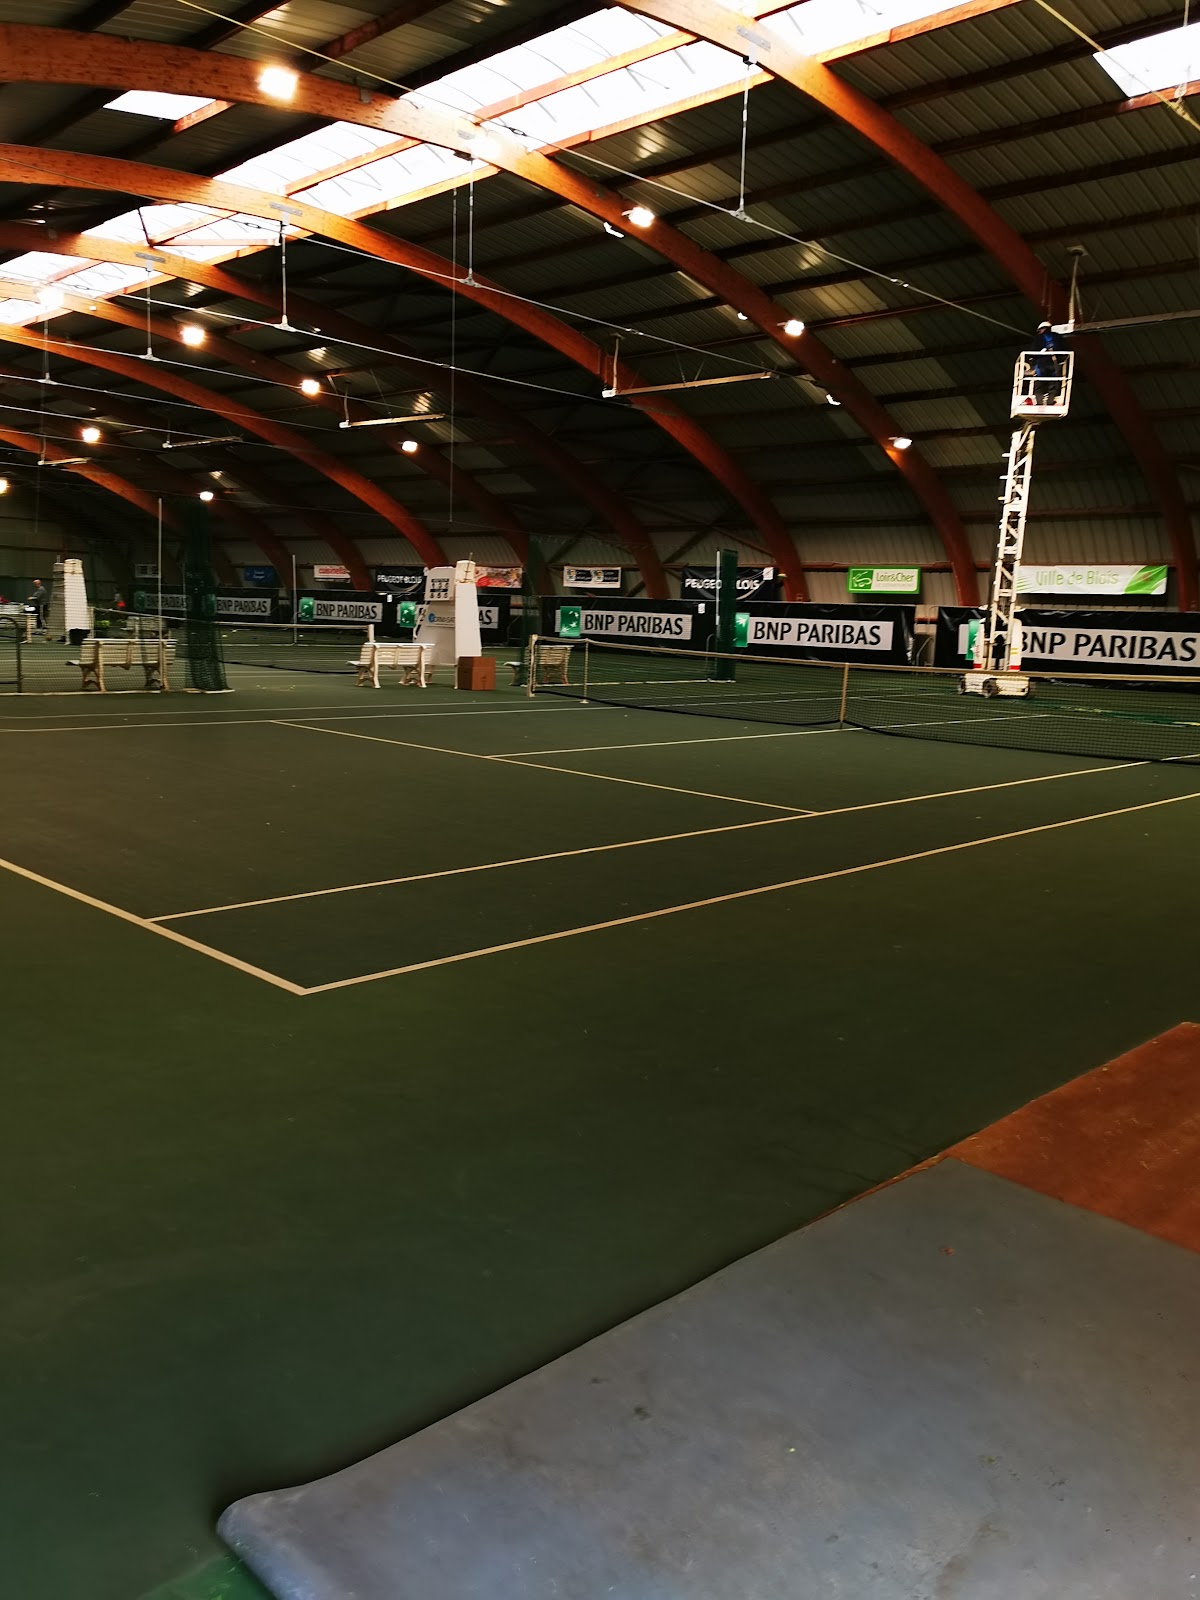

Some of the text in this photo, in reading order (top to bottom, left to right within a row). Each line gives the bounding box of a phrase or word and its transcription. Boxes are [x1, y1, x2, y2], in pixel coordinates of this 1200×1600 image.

[685, 578, 760, 591] PEUGEO LOIS
[1036, 571, 1119, 586] Ville de Blois
[217, 599, 268, 614] BNP PARIBAS
[316, 603, 378, 620] BNP PARIBAS
[584, 614, 683, 636] BNP PARIBAS
[753, 621, 881, 645] BNP PARIBAS
[1073, 633, 1197, 662] PARIBAS
